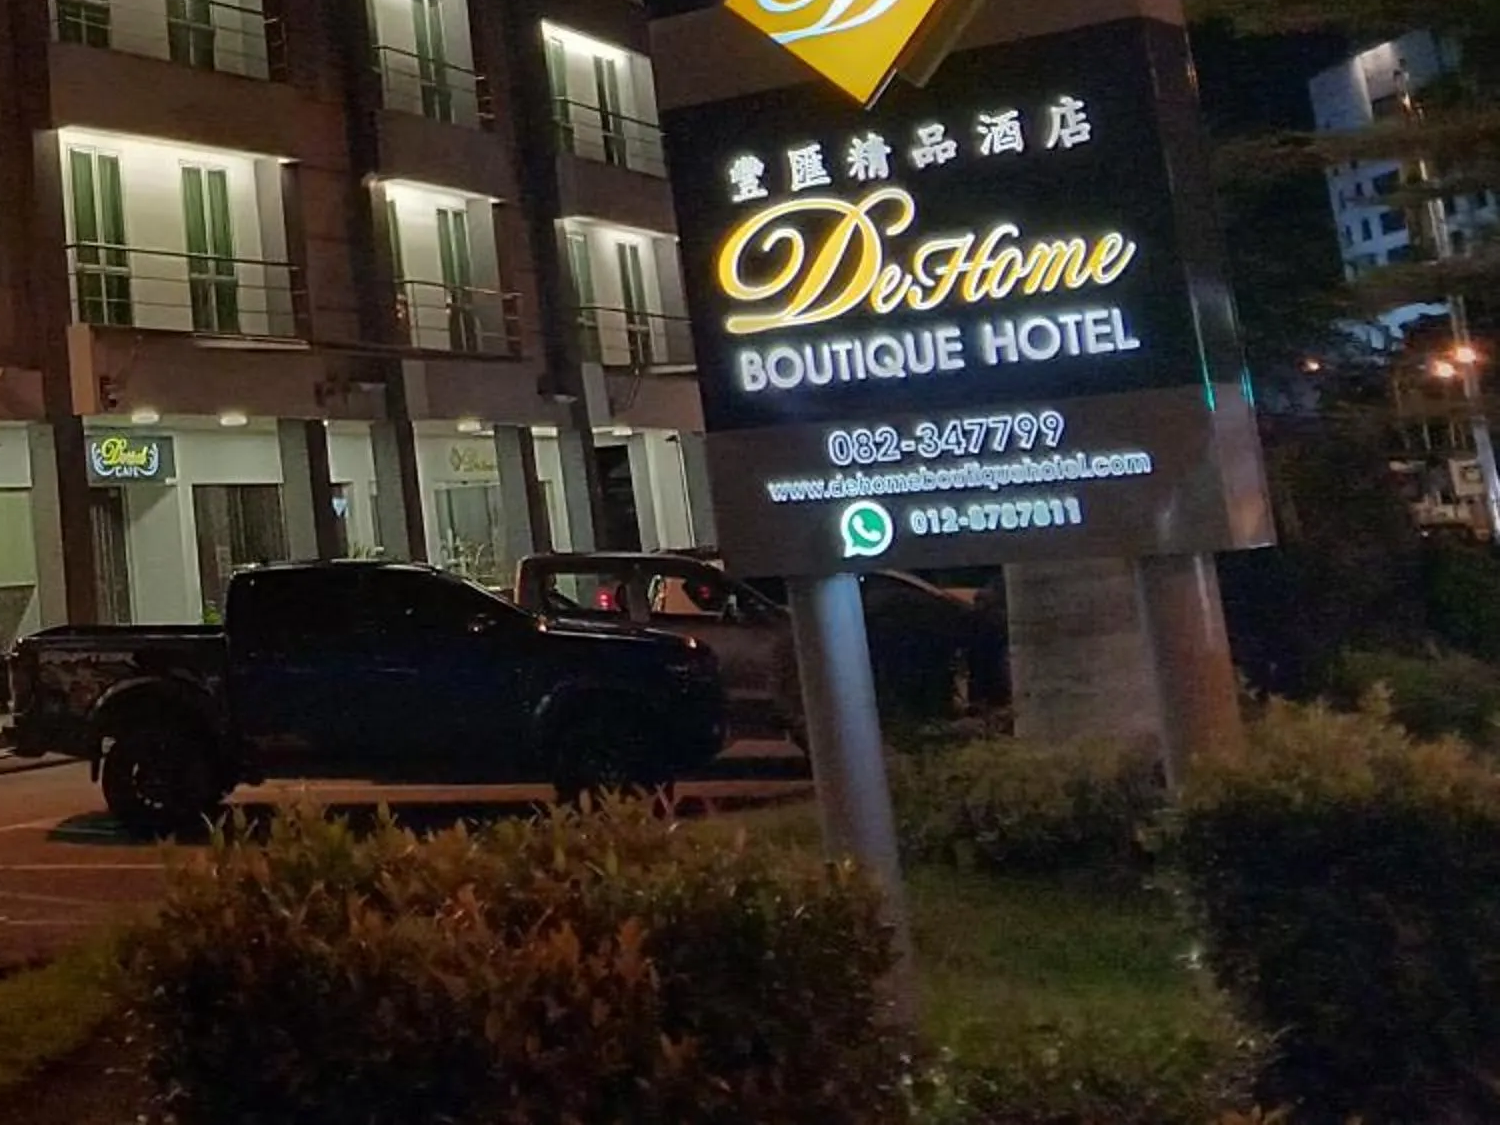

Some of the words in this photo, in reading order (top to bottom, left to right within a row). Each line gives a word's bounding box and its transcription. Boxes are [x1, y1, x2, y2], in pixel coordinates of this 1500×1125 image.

[740, 325, 965, 392] BOUTIQUE
[983, 307, 1141, 365] HOTEL
[827, 410, 1065, 466] 082-347799
[767, 449, 1152, 503] www.dehomeboutiquehotel.com
